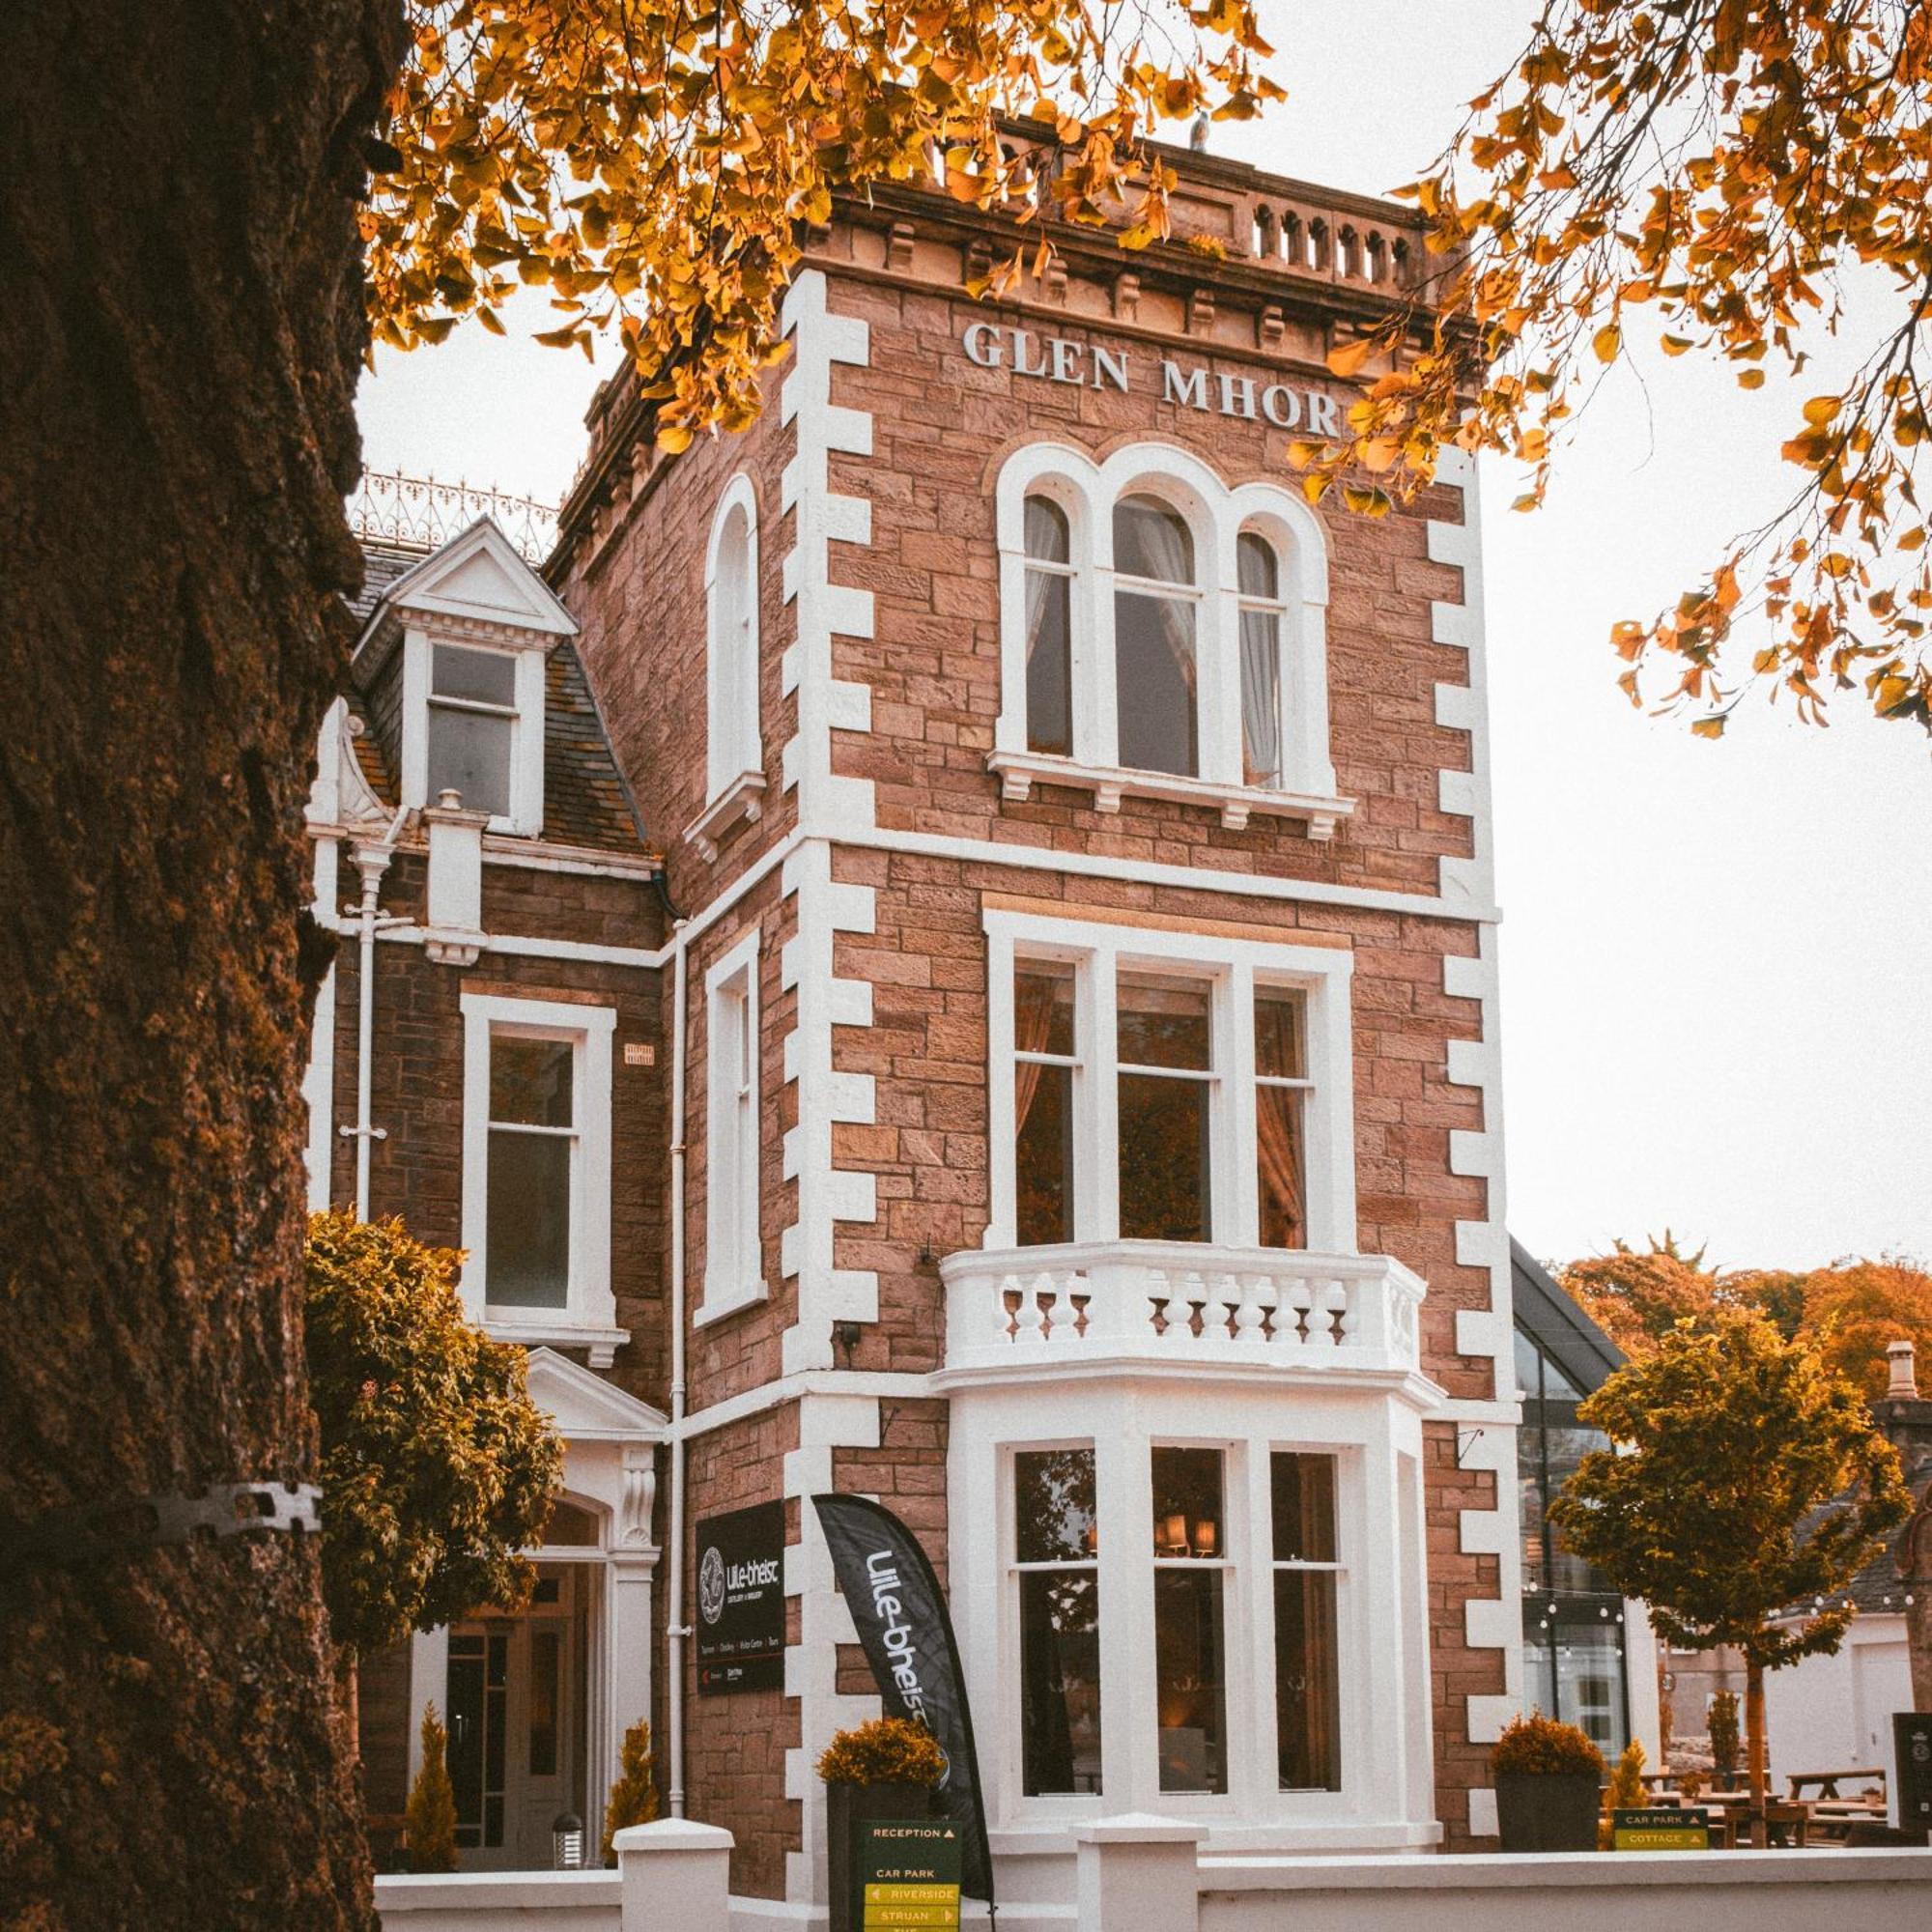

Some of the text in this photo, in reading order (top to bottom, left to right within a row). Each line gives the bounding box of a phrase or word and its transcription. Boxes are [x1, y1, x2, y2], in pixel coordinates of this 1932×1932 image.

[964, 324, 1339, 438] GLEN MHOR
[1626, 1816, 1682, 1825] CAR PARK
[873, 1829, 941, 1837] RECEPTION
[1629, 1834, 1682, 1843] COTTAGE
[876, 1869, 900, 1878] CAR
[892, 1889, 953, 1898] RIVERSIDE
[881, 1912, 928, 1920] STRUAN
